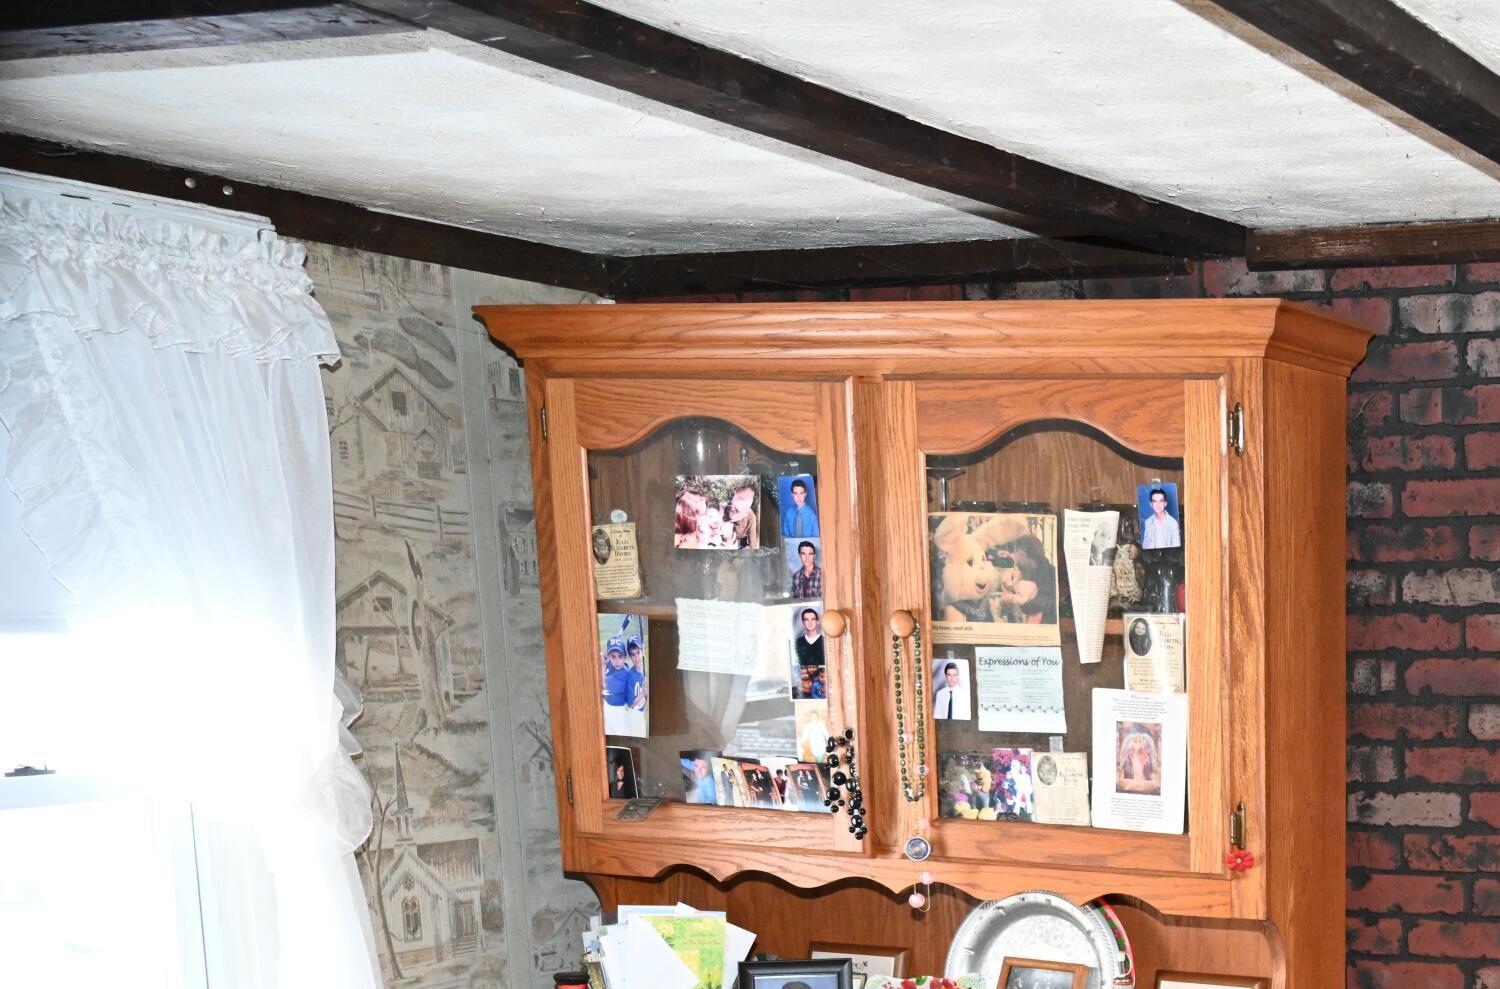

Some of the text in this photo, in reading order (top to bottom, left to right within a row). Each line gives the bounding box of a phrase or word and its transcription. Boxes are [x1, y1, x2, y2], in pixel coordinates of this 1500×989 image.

[978, 656, 1060, 668] Expressions of You
